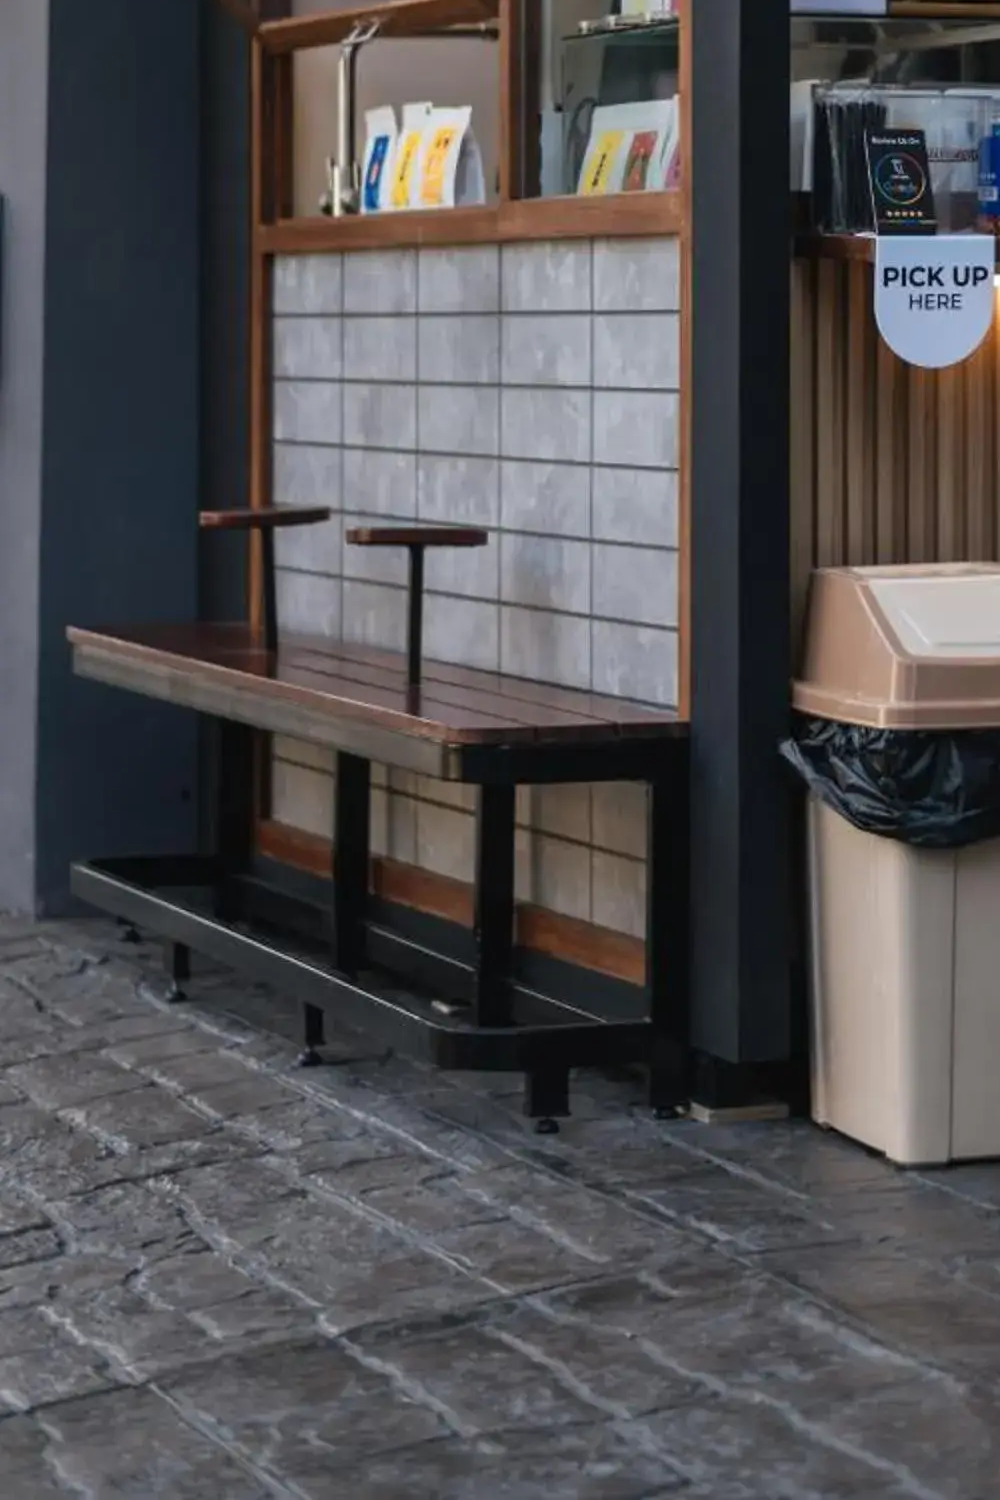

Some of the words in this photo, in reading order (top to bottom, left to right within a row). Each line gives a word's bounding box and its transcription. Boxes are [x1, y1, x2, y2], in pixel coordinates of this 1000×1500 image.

[883, 266, 945, 288] PICK
[953, 266, 989, 288] UP
[909, 293, 963, 311] HERE
